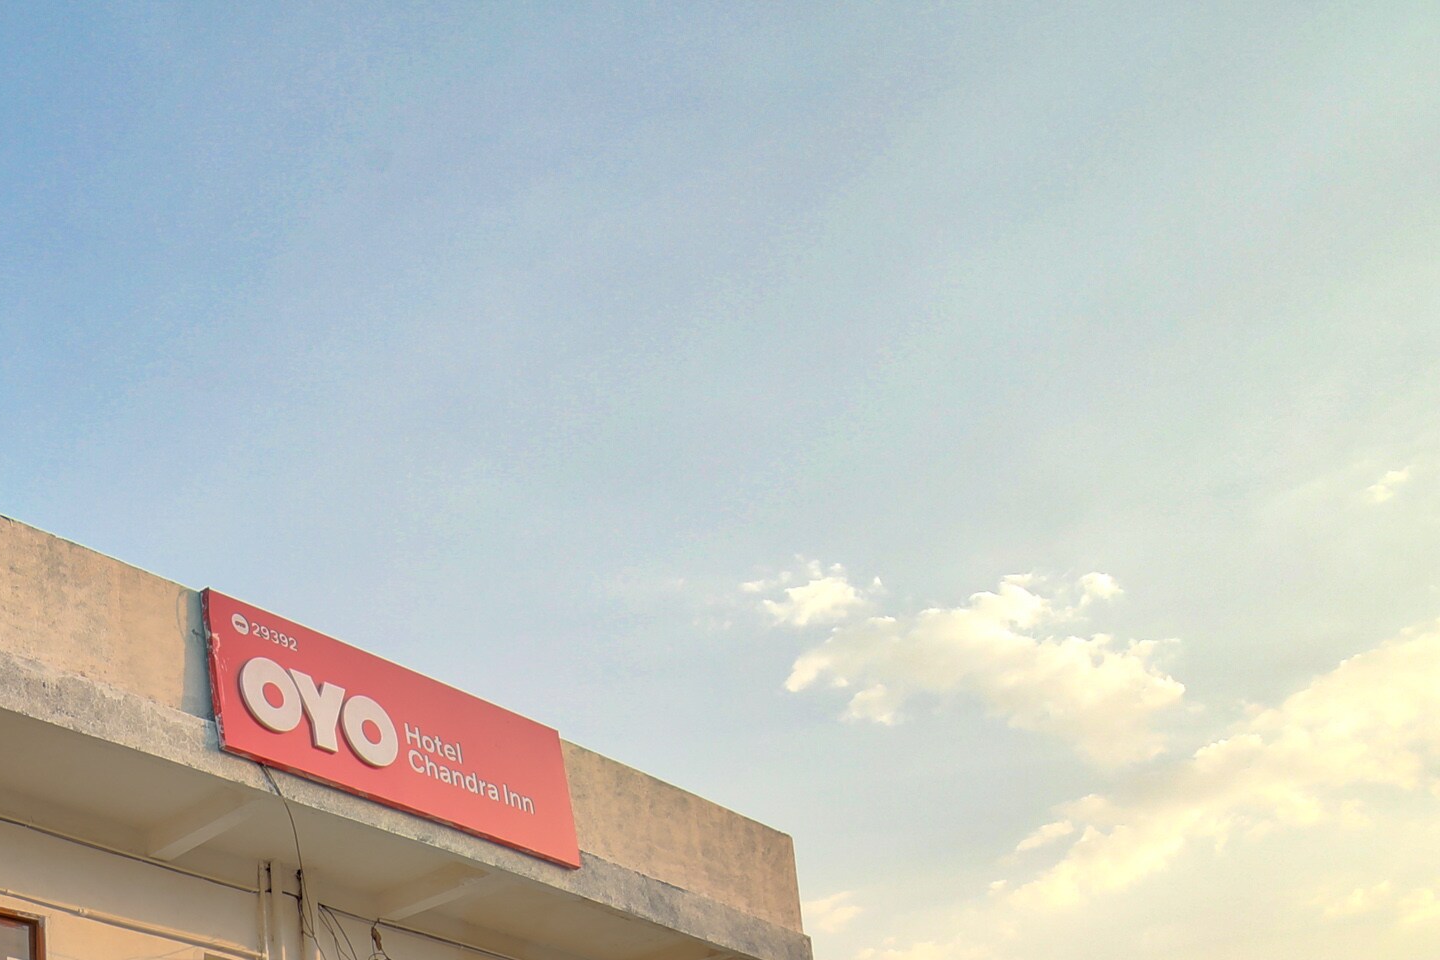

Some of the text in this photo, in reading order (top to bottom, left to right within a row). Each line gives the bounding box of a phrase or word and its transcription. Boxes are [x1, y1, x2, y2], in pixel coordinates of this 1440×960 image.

[252, 622, 298, 652] 29392
[240, 656, 399, 768] OYO
[404, 722, 463, 765] Hotel
[408, 749, 535, 815] Chandra Inn
